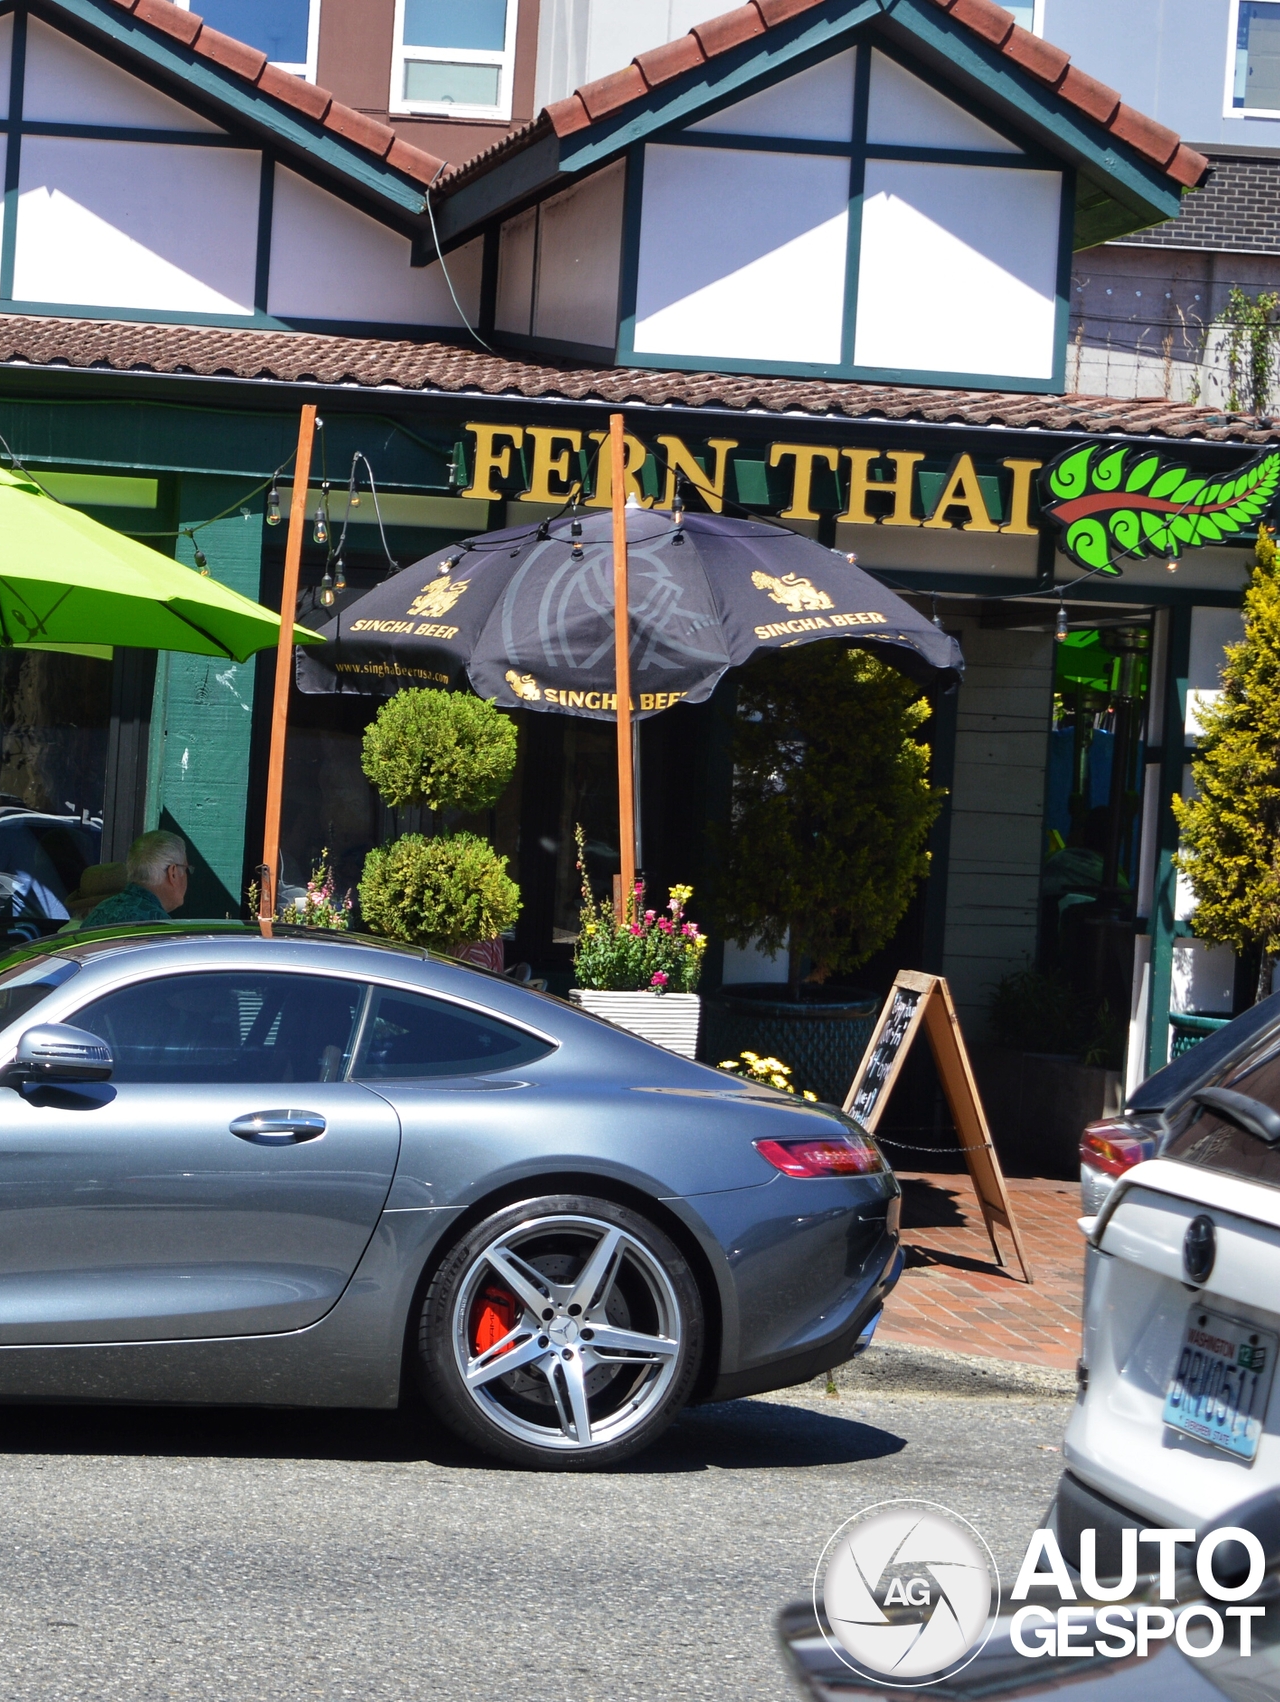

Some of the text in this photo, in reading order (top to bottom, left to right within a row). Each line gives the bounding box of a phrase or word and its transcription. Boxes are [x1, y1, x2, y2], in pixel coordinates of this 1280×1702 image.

[461, 422, 1043, 535] FERN THAI
[349, 619, 459, 639] SINGHA BEER
[753, 612, 888, 640] SINGHA BEER
[335, 661, 449, 685] www.singhabeerusa.com
[543, 688, 688, 711] SINGH BEE
[1187, 1327, 1236, 1359] WASHINGTON
[1184, 1418, 1231, 1445] EVERGREEN STATE
